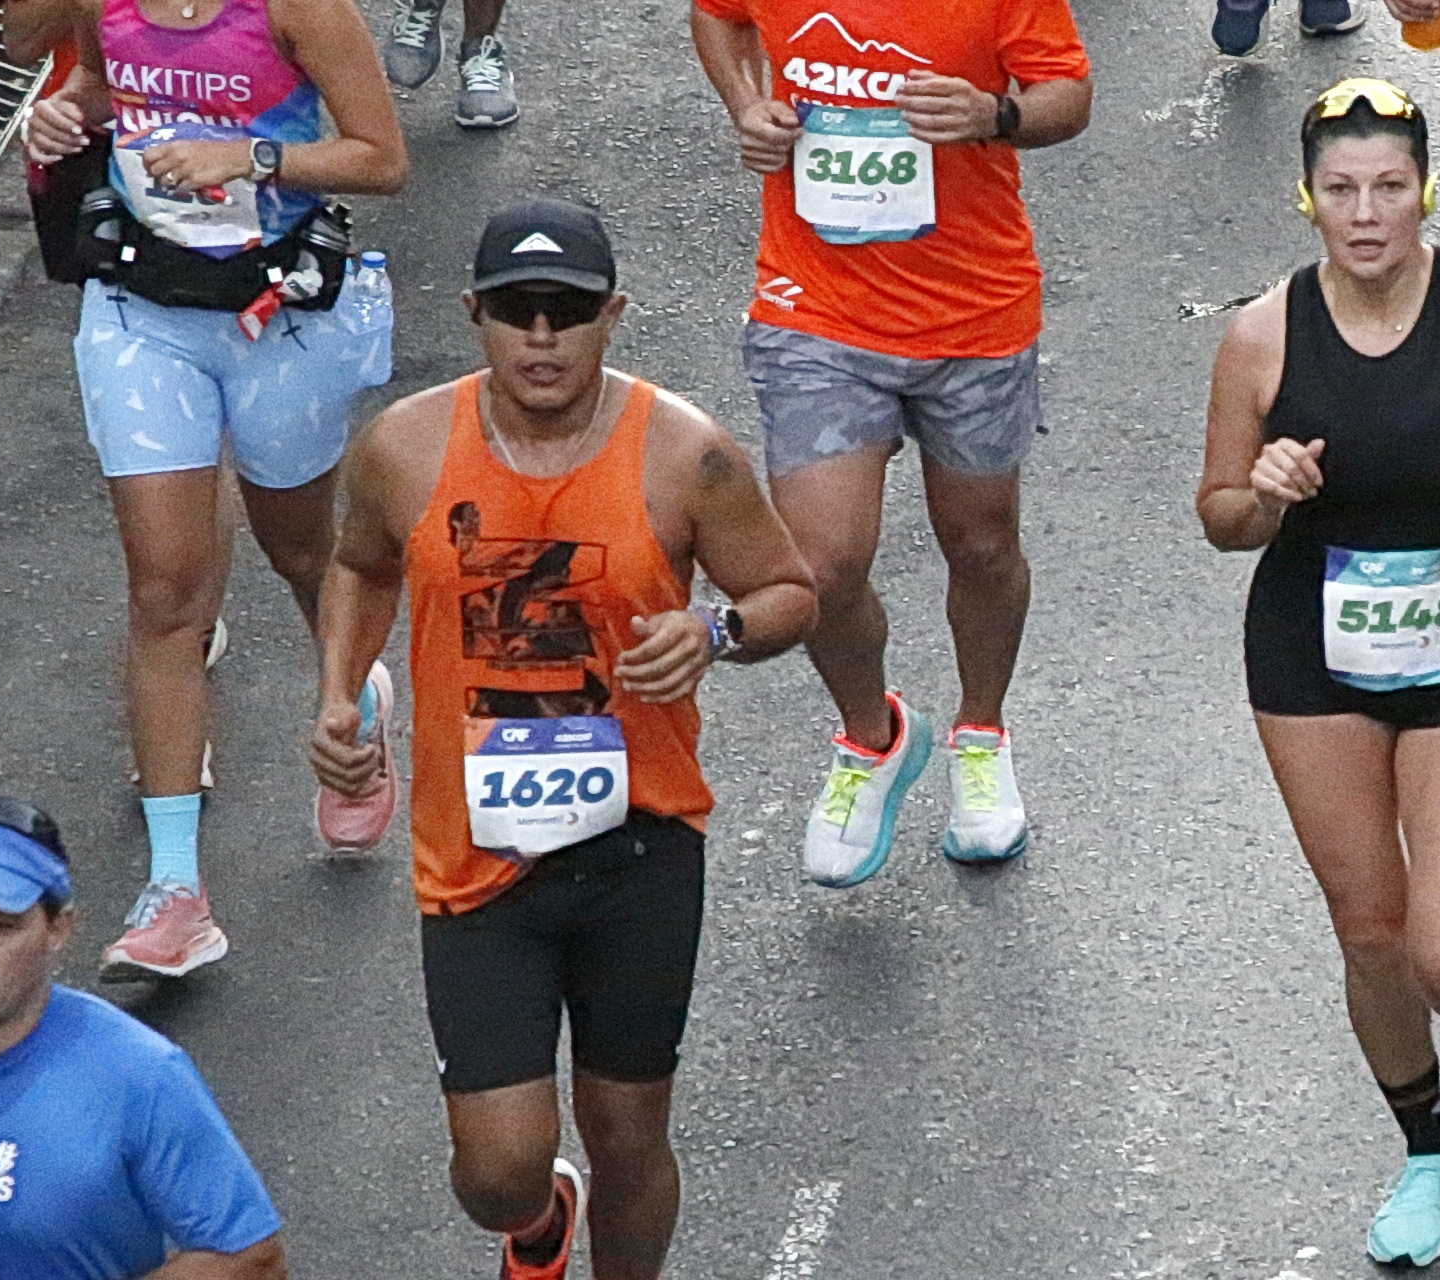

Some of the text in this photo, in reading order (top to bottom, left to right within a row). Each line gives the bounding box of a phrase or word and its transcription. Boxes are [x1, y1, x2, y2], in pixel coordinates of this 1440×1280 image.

[105, 57, 253, 103] KAKITIPS
[805, 147, 917, 185] 3168
[479, 766, 615, 809] 1620
